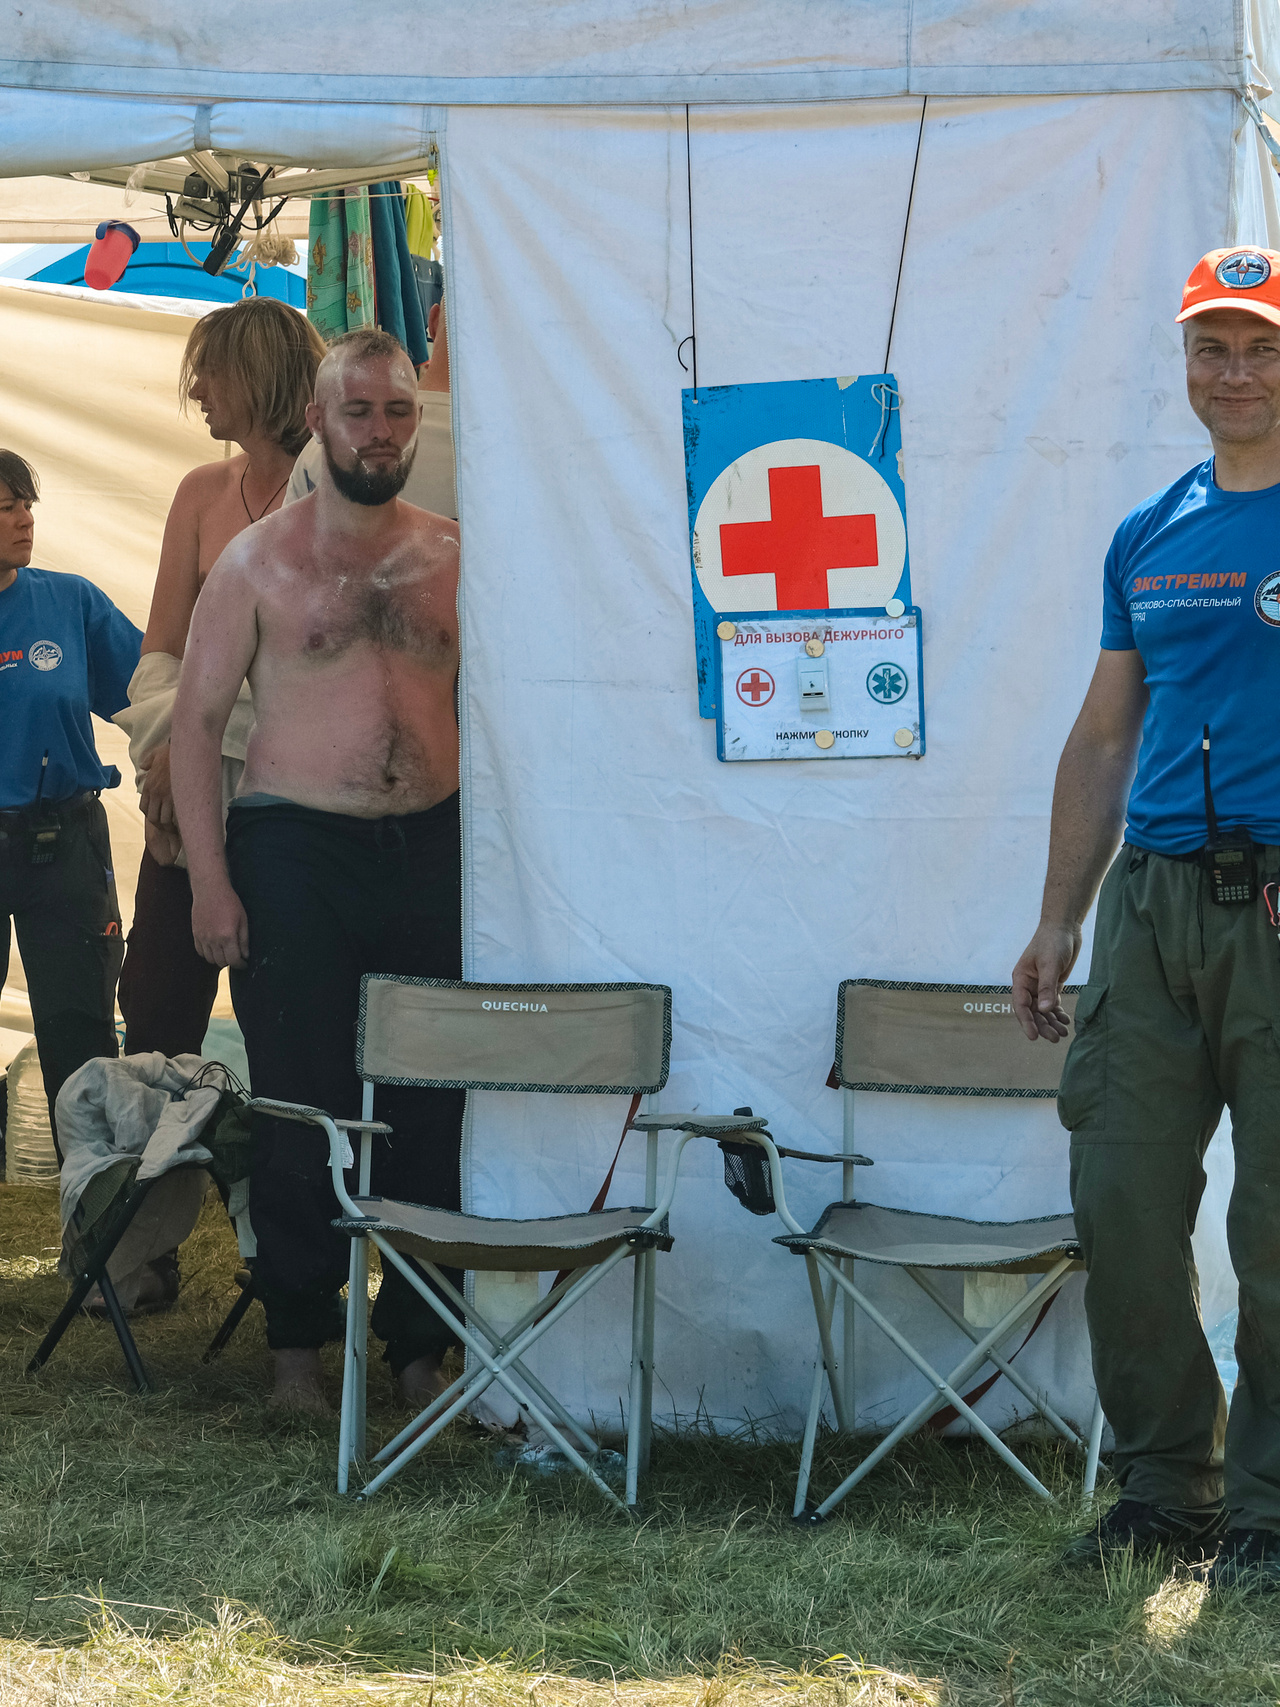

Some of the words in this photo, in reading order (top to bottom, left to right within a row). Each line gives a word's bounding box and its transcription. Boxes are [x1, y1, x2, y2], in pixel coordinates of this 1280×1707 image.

[1132, 572, 1247, 592] ЭКСТРЕМУМ
[734, 633, 762, 647] ДЛЯ
[766, 631, 820, 643] ВЫЗОВА
[822, 628, 905, 644] ДЕЖУРНОГО
[776, 731, 819, 740] НАЖМИ
[832, 729, 869, 738] НОПКУ
[481, 1000, 549, 1013] QUECHUA
[963, 1002, 1014, 1014] QUECH
